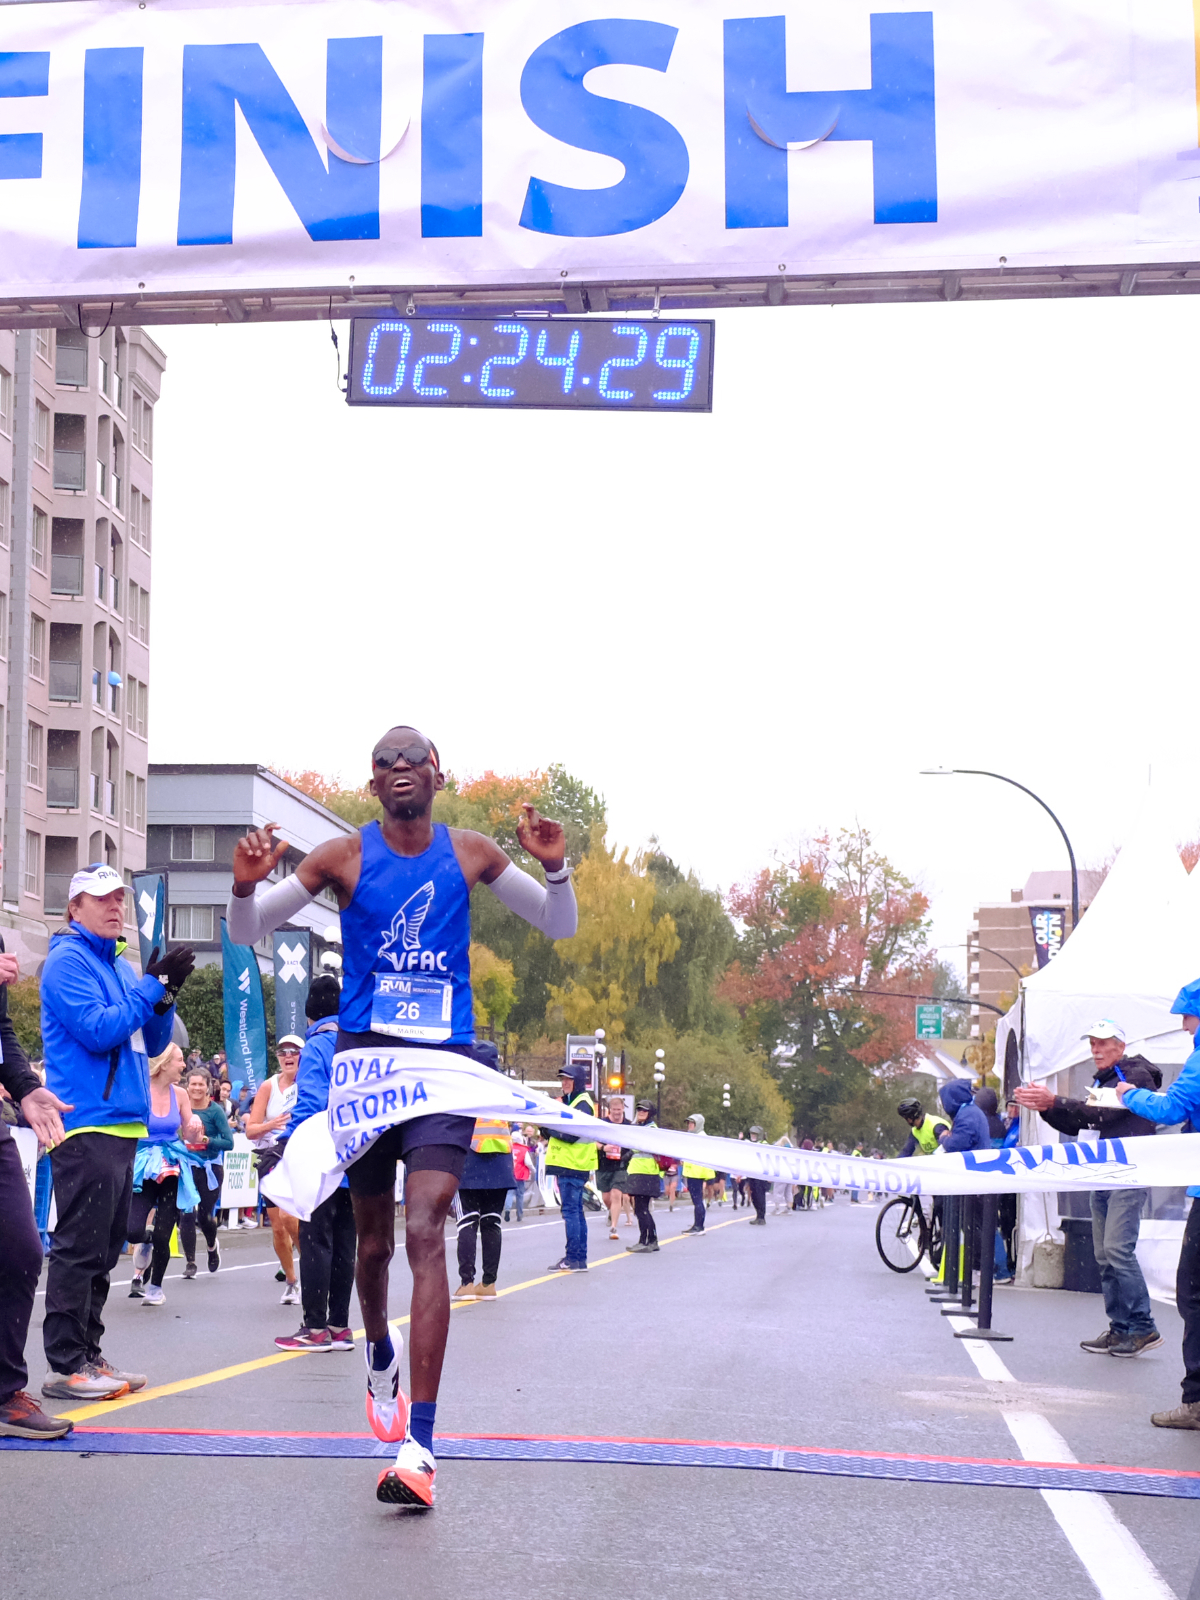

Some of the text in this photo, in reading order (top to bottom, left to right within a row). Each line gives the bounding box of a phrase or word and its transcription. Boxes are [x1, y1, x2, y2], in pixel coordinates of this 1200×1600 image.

[362, 322, 700, 401] 02:24.29
[1036, 914, 1048, 945] OUR
[391, 951, 448, 971] VFAC
[380, 980, 412, 993] RVM
[395, 1001, 420, 1020] 26
[239, 998, 259, 1098] Westland Insura
[328, 1081, 428, 1132] ICTORIA
